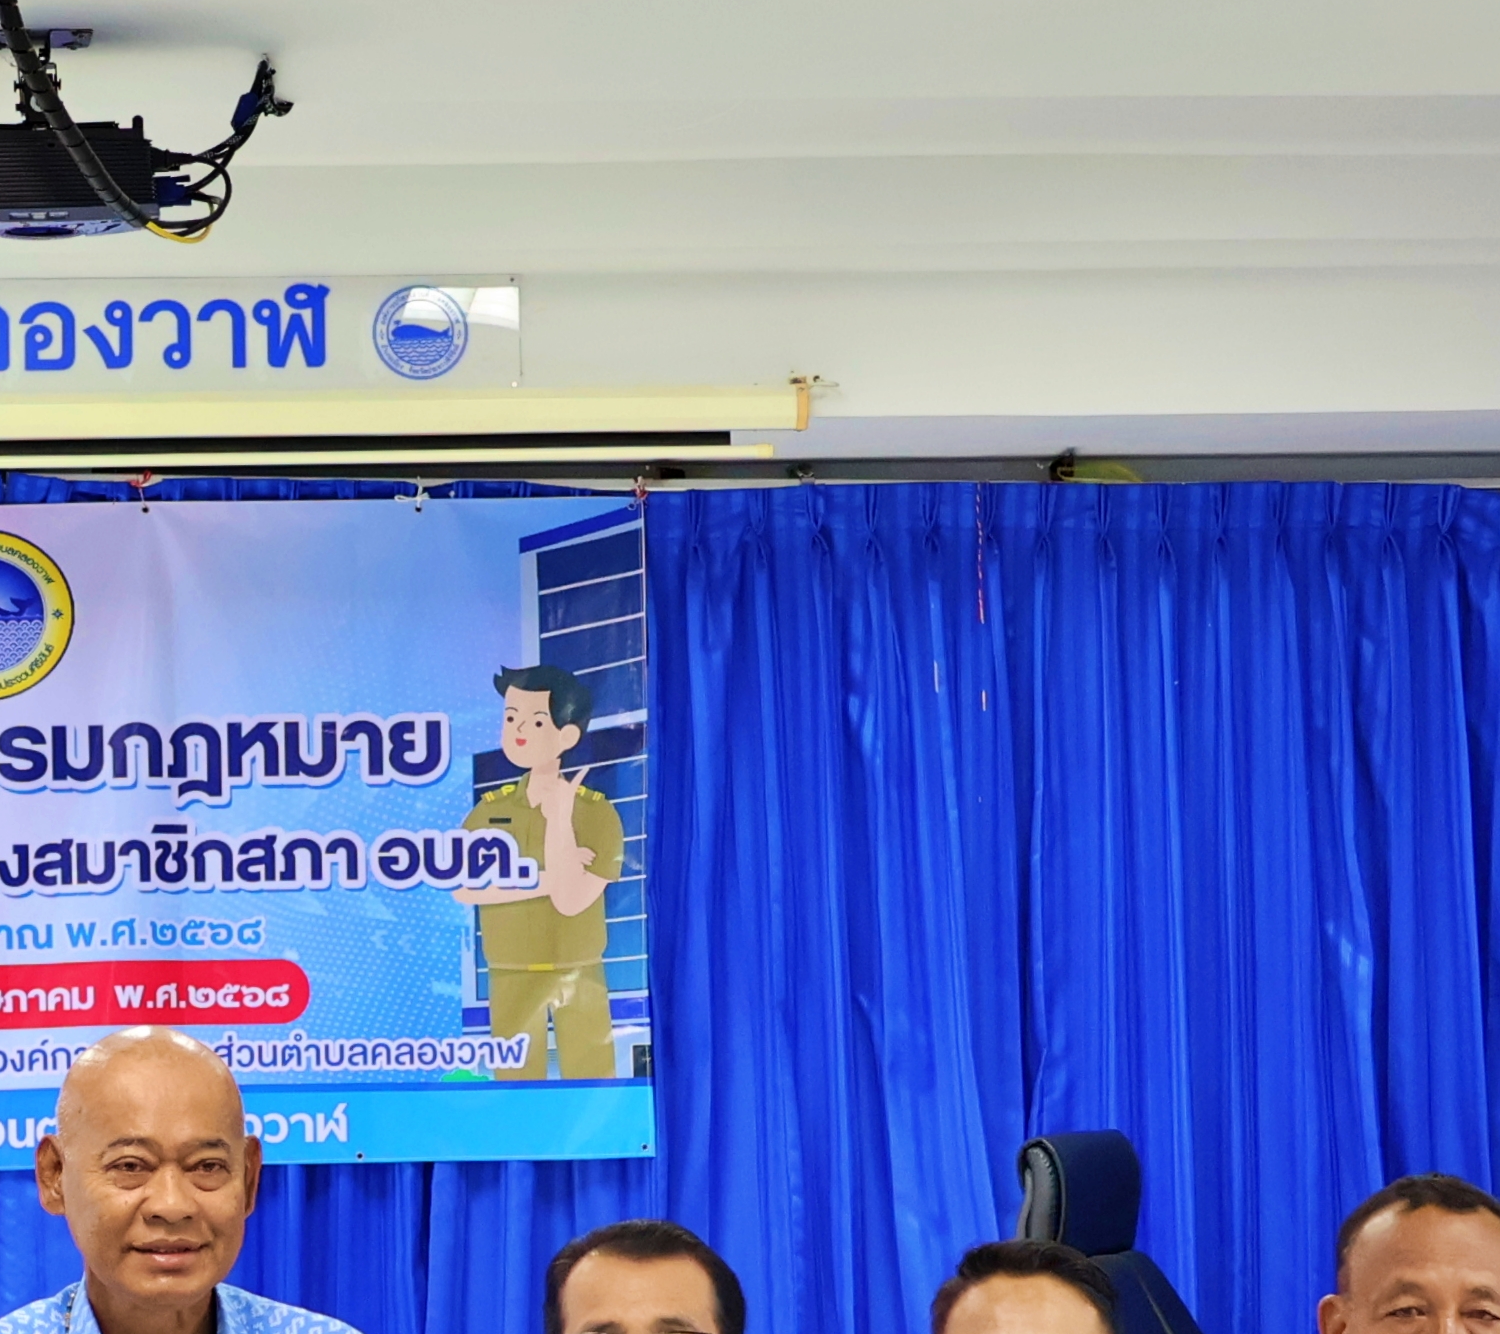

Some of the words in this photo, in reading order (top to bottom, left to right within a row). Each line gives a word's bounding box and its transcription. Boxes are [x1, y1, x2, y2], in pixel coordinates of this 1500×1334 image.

[377, 830, 531, 884] อบต.
[66, 916, 264, 950] พ.ศ.๒๕๖๘
[114, 980, 292, 1012] พ.ศ.๒๕๖๘
